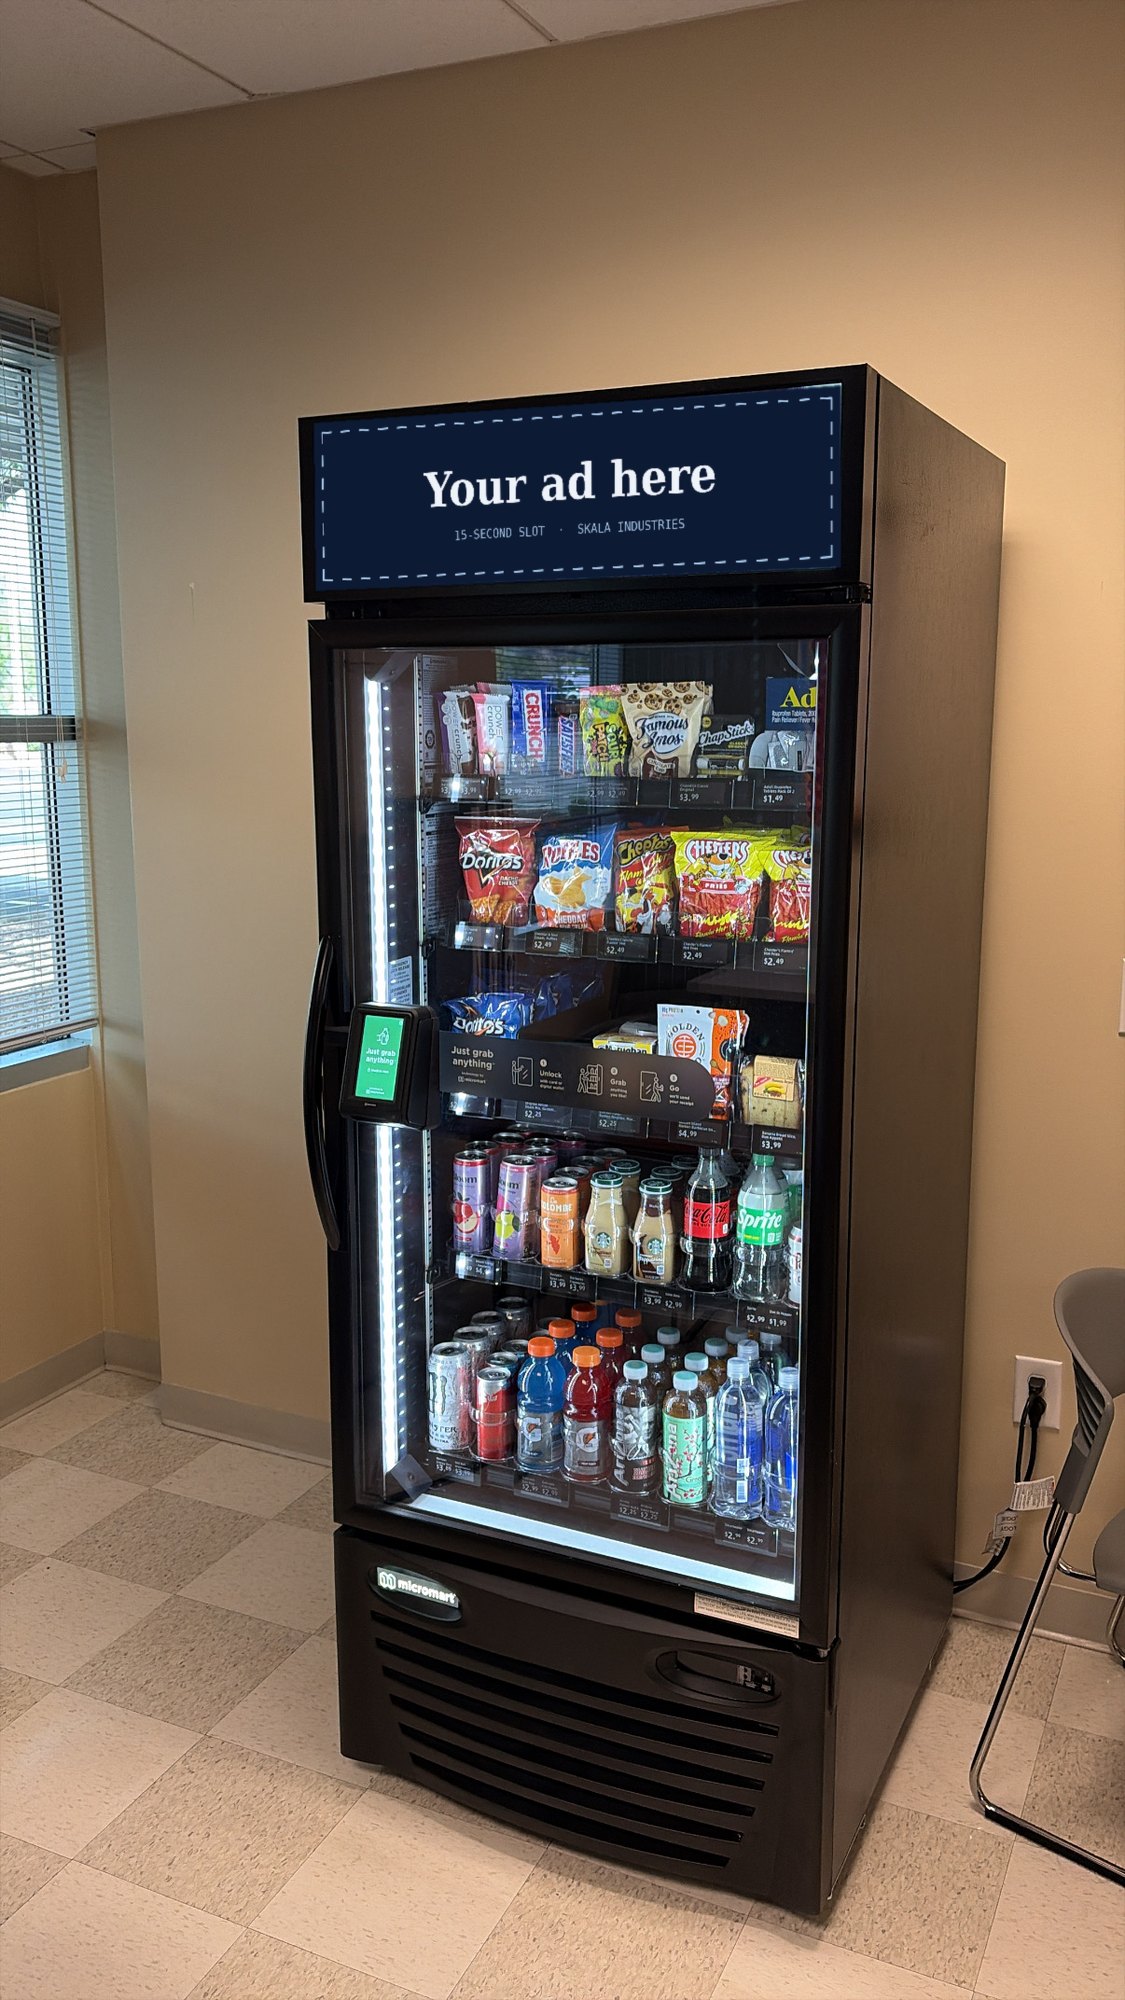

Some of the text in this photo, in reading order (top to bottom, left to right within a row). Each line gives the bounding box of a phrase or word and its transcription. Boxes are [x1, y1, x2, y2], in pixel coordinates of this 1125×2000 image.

[422, 458, 716, 508] Your ad here
[454, 518, 686, 541] 15-SECOND SLOT SKALA INDUSTRIES
[487, 705, 496, 740] crunch
[492, 705, 504, 741] power
[524, 692, 544, 759] CRUNCH
[634, 717, 689, 740] Famous
[699, 720, 752, 747] ChapStick
[454, 728, 463, 760] crunch
[594, 722, 609, 762] PATCH
[605, 723, 619, 760] SOUR
[679, 793, 700, 802] $3.99
[763, 794, 784, 804] $1.49
[617, 834, 672, 867] Cheetos
[462, 853, 522, 870] Doritos
[533, 941, 552, 950] $2.49
[606, 946, 625, 955] $2.49
[682, 951, 703, 960] $2.49
[763, 957, 784, 966] $2.49
[365, 1047, 380, 1055] Just
[451, 1045, 494, 1059] Just grab
[365, 1056, 394, 1066] anything
[452, 1058, 493, 1071] anything
[539, 1069, 563, 1079] Unlock
[610, 1078, 627, 1087] Grab
[524, 1110, 542, 1119] $2.25
[599, 1119, 617, 1128] $2.25
[678, 1129, 698, 1138] $4.99
[761, 1140, 782, 1149] $3.99
[737, 1208, 783, 1229] Sprite
[643, 1297, 683, 1309] $3.99 $2.99
[746, 1314, 787, 1327] $2.99 $1.99
[662, 1424, 682, 1500] AriZna
[397, 1579, 457, 1604] micromart
